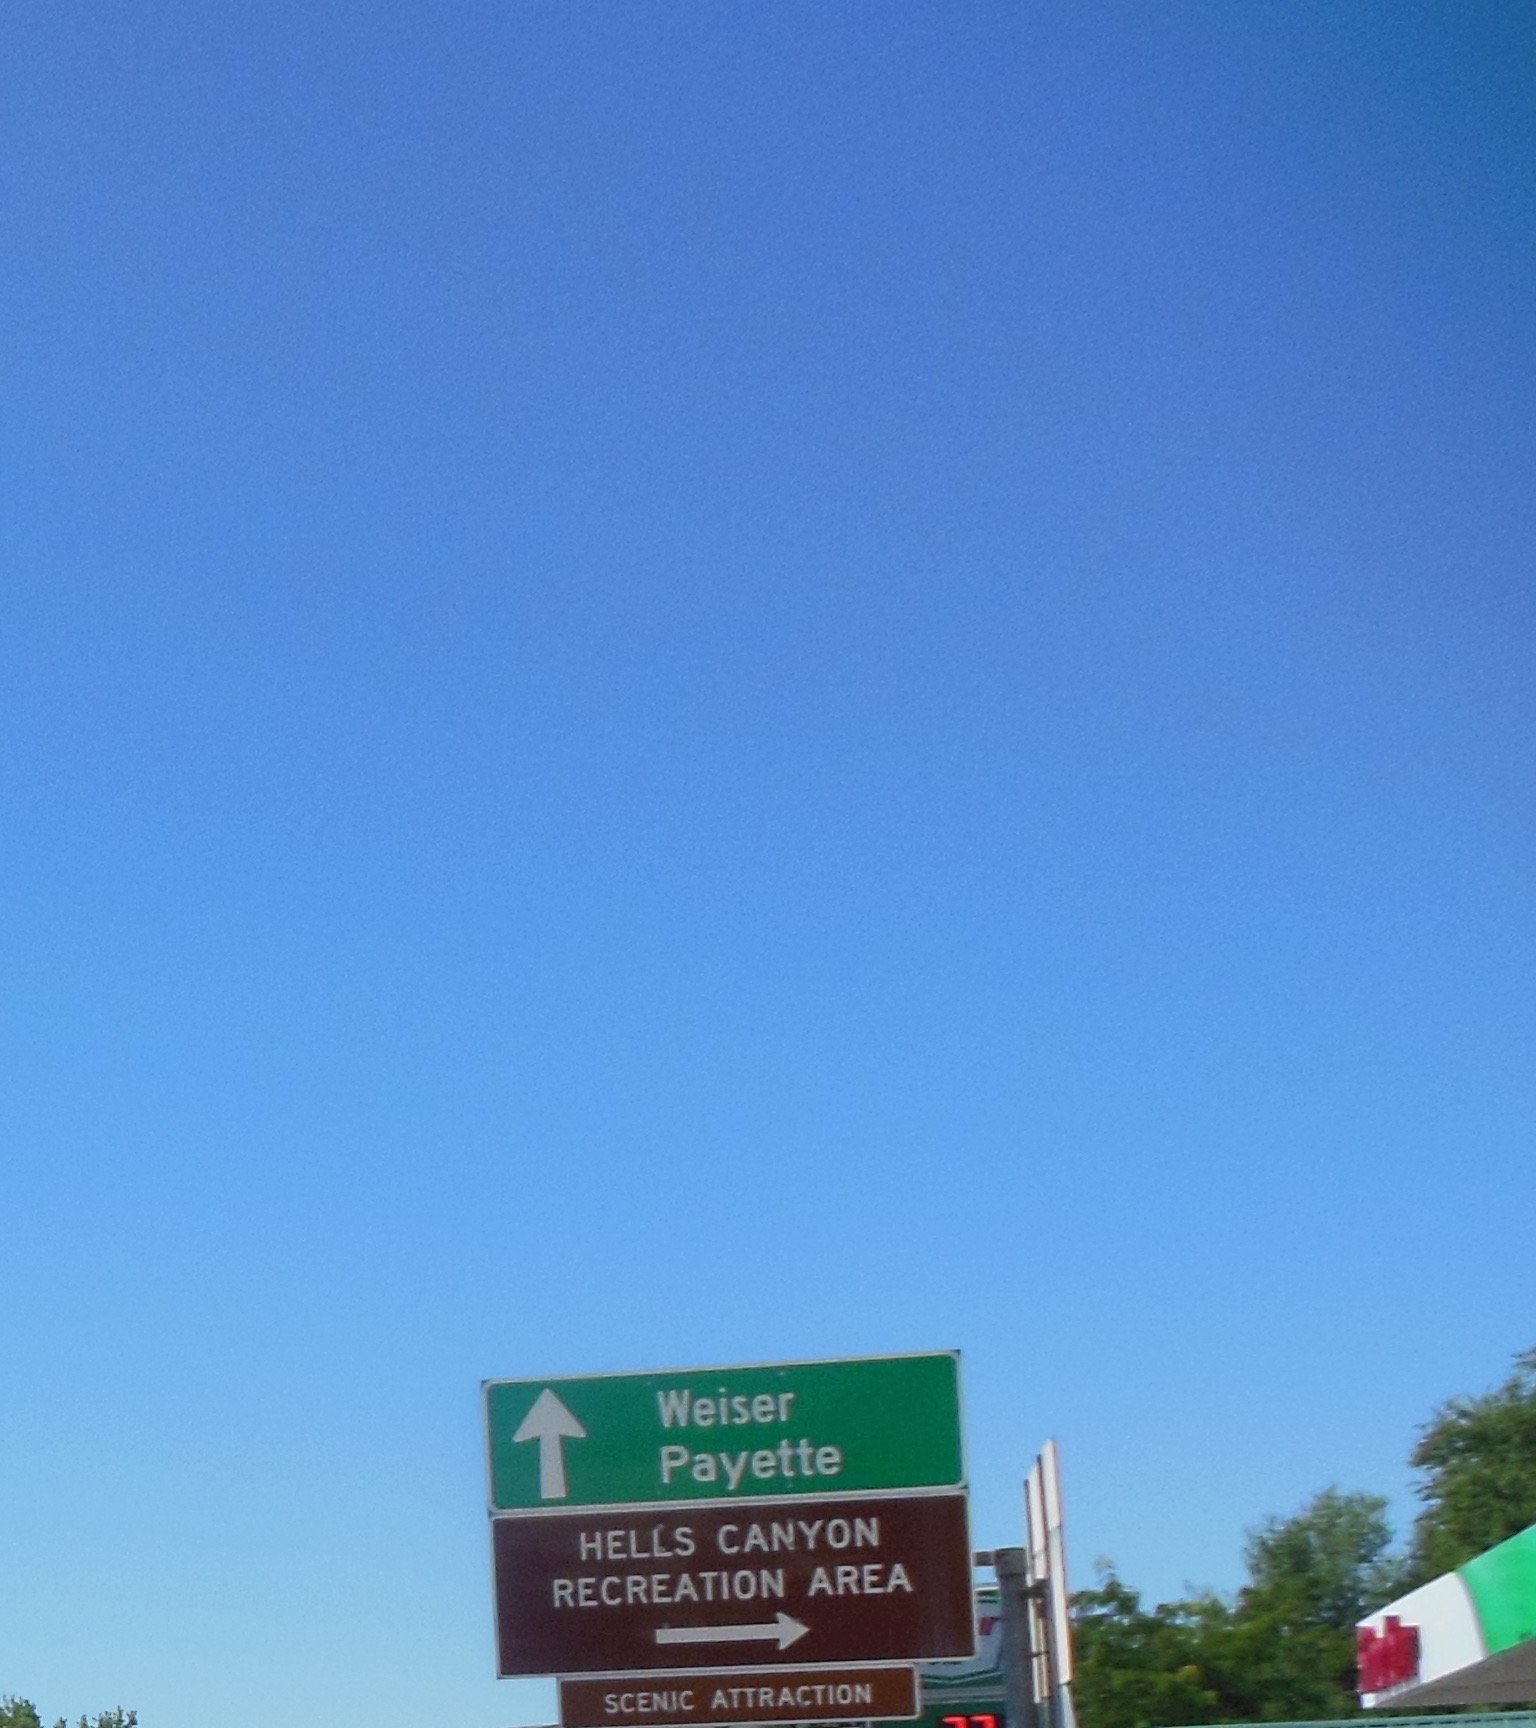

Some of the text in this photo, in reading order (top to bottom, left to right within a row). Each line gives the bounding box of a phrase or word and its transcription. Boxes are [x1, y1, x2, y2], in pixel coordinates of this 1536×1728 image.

[657, 1387, 797, 1428] Weiser
[660, 1438, 844, 1490] Payette
[579, 1517, 880, 1561] HELLS CANYON
[553, 1563, 914, 1608] RECREATION AREA
[604, 1683, 873, 1714] SCENIC ATTRACTION
